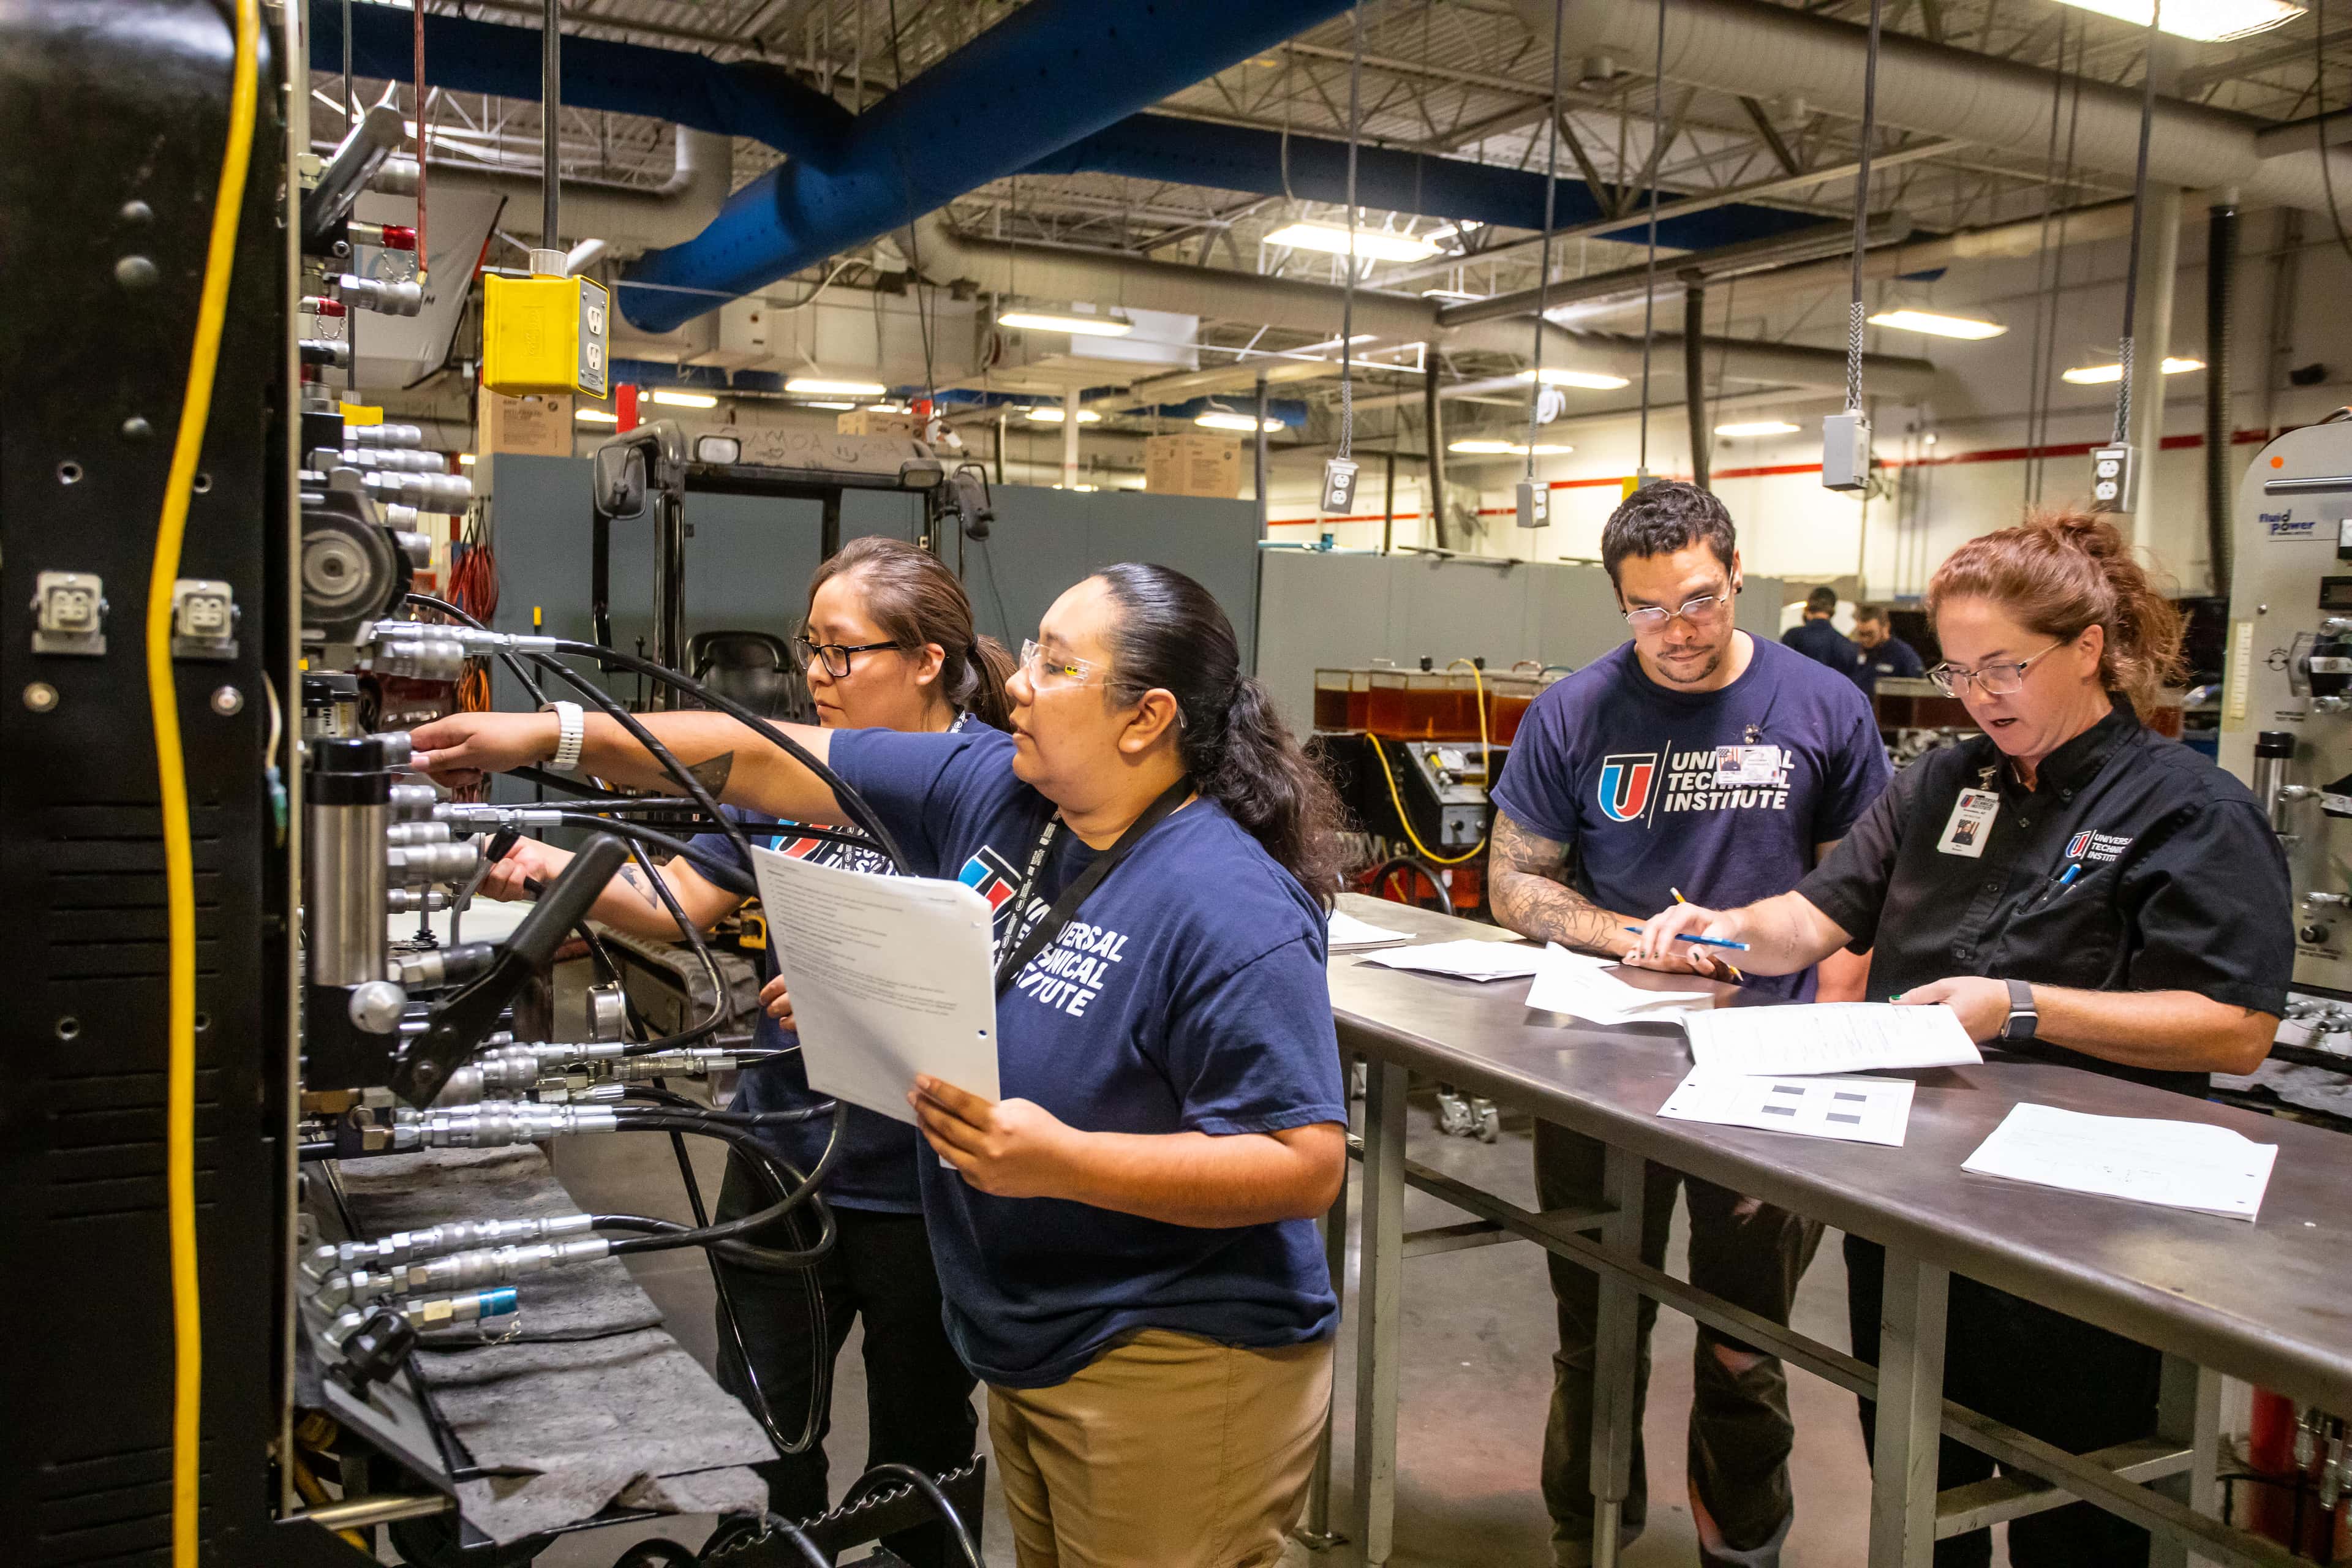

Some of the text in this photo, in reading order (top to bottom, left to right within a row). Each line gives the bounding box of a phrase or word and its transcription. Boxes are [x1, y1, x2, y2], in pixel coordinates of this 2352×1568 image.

[2270, 522, 2315, 535] power
[1664, 790, 1789, 812] INSTITUTE
[2094, 834, 2133, 845] UNIVERS
[2092, 842, 2126, 853] TECHNIC
[2087, 851, 2117, 862] INSTIT
